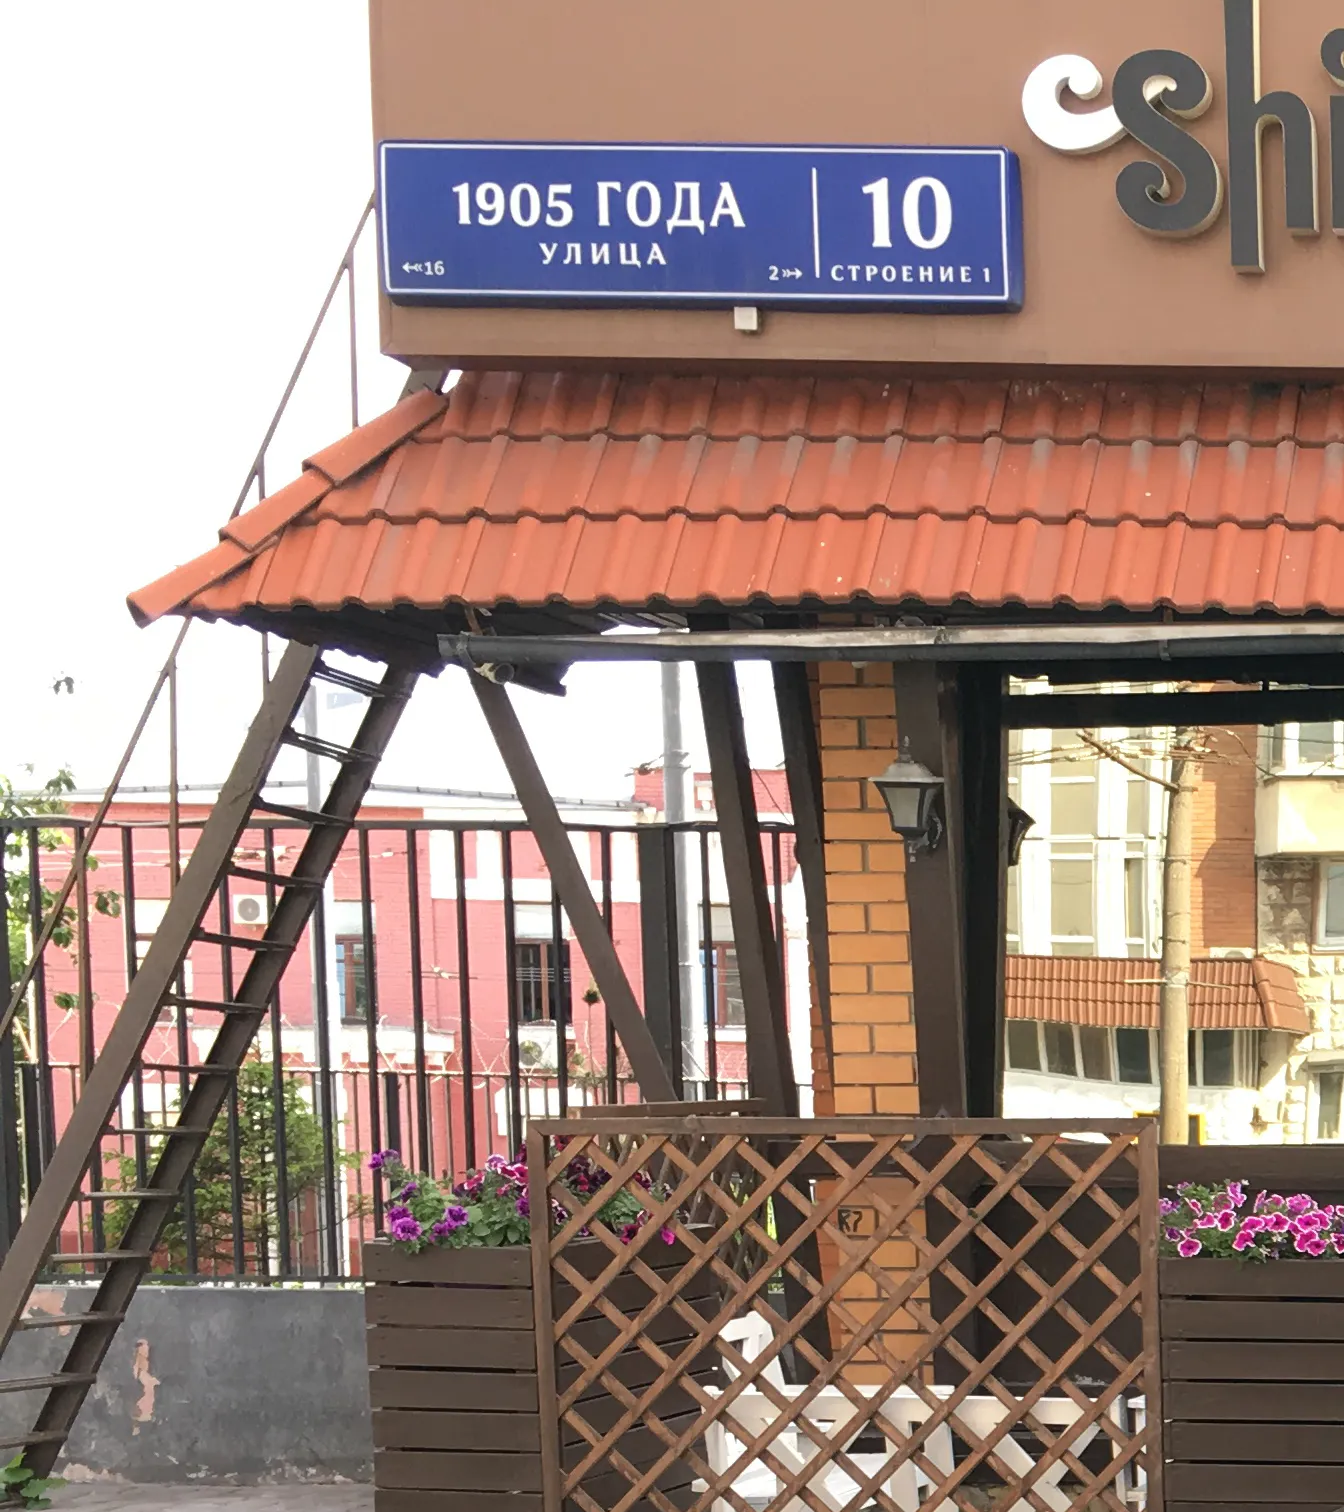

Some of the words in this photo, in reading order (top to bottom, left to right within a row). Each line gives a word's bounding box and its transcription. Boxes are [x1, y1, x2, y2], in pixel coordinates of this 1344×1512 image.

[452, 181, 574, 228] 1905
[596, 180, 747, 235] ГОДА
[861, 175, 953, 250] 10
[539, 242, 667, 269] УЛИЦА
[424, 260, 445, 276] 16
[768, 265, 780, 281] 2
[830, 264, 972, 283] СТРОЕНИЕ
[982, 267, 991, 283] 1
